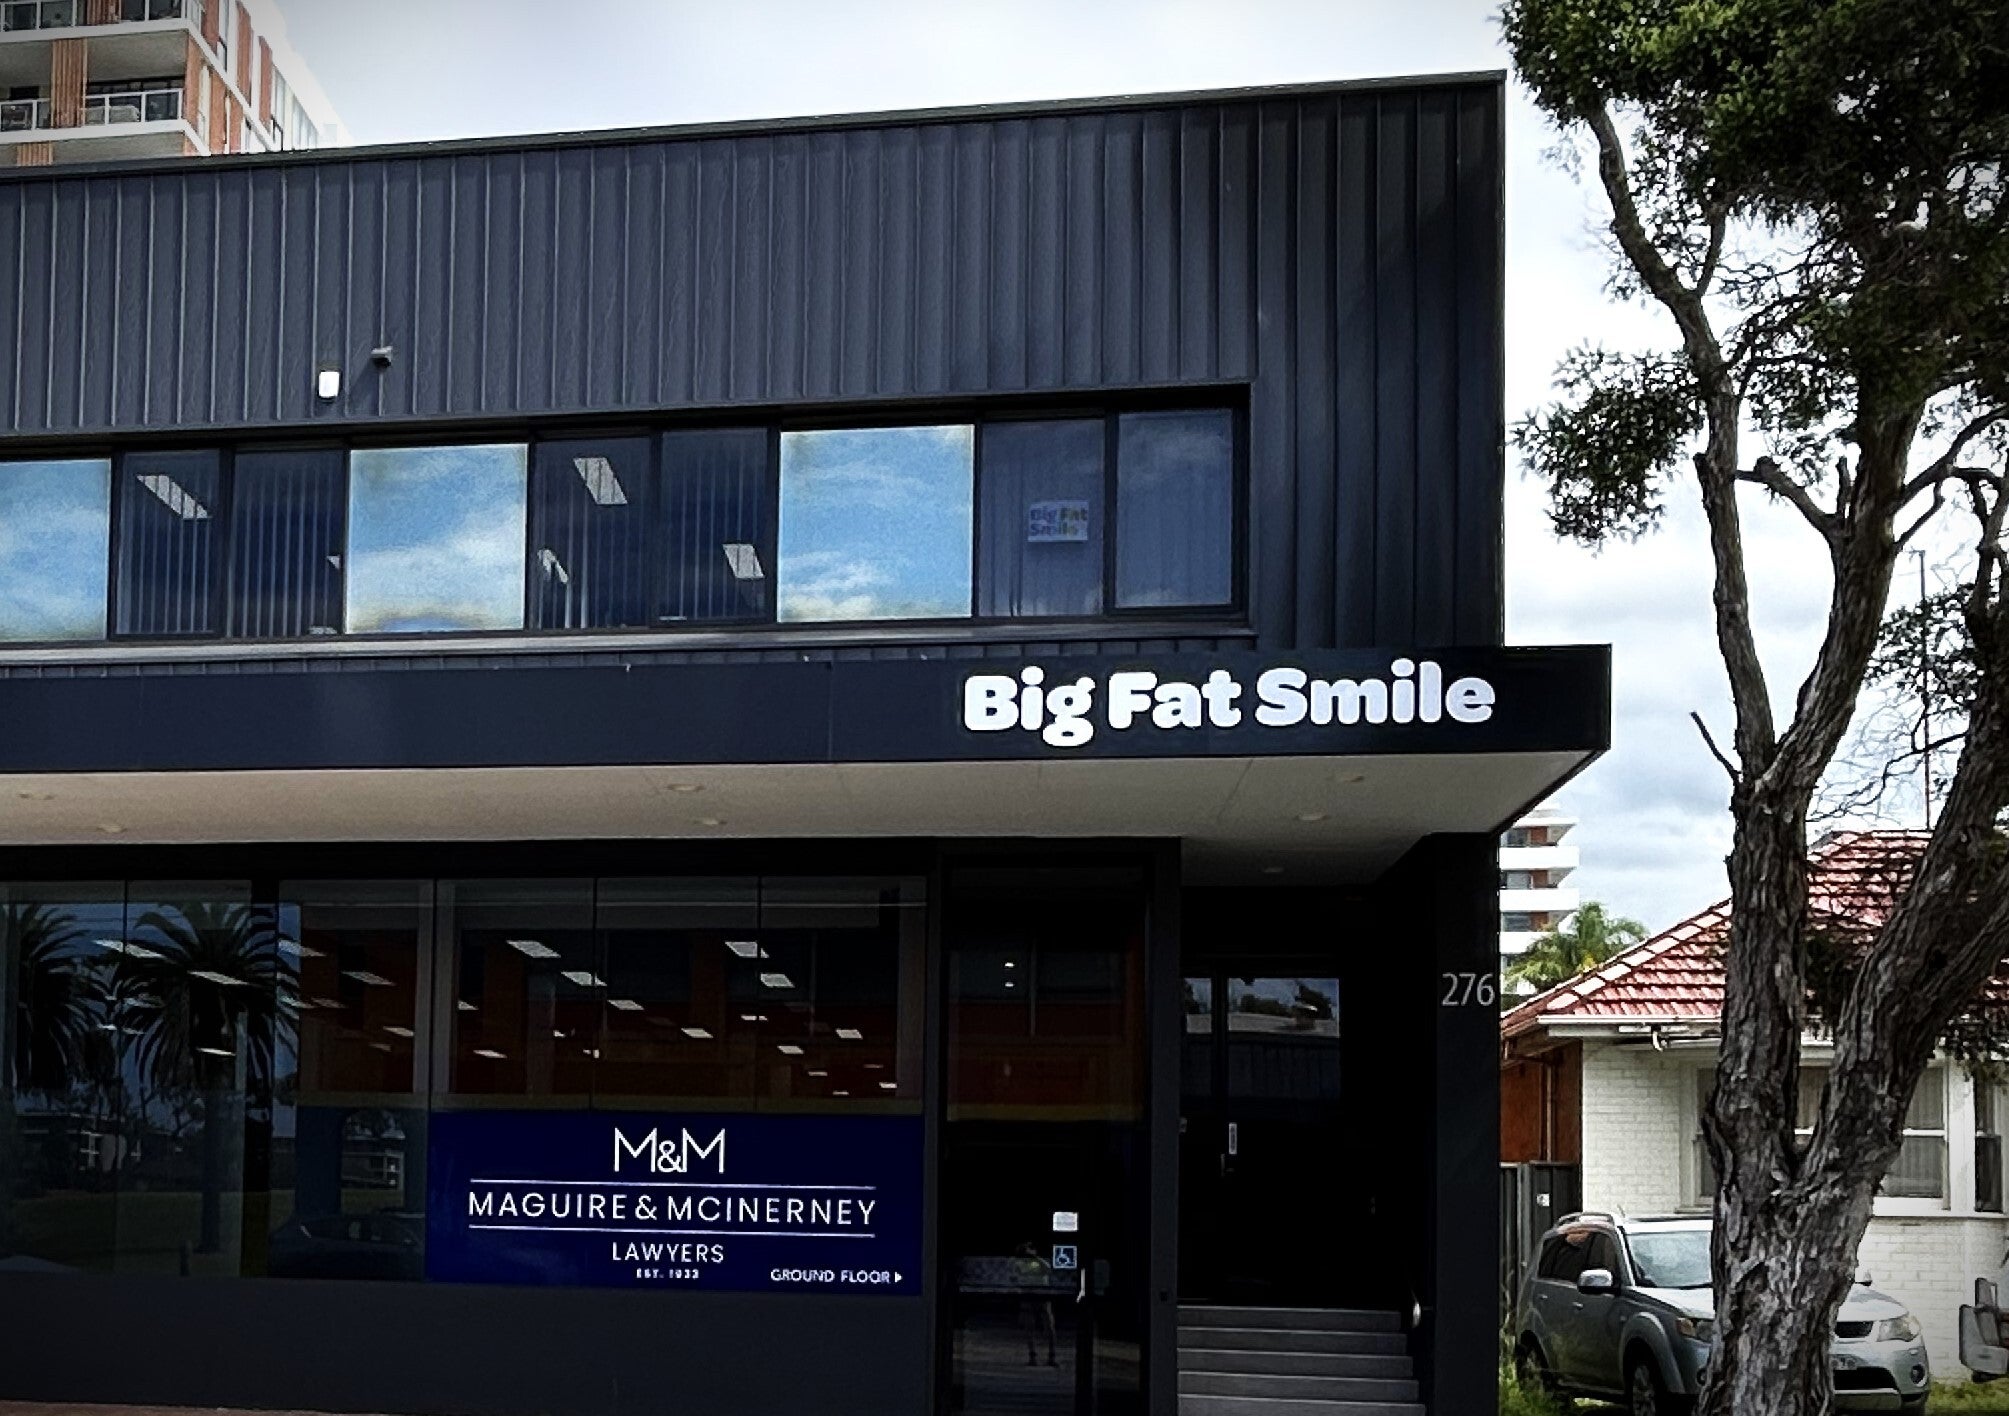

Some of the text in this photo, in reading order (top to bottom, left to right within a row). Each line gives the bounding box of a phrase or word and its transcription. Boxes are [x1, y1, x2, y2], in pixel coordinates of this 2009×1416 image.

[963, 657, 1497, 747] Big Fat Smile
[1442, 972, 1496, 1007] 276
[613, 1127, 726, 1174] M&M
[468, 1191, 876, 1225] MAGUIRE & MCINERNEY
[612, 1241, 724, 1264] LAWYERS
[636, 1267, 665, 1279] EST.
[770, 1268, 891, 1285] GROUND FLOOR
